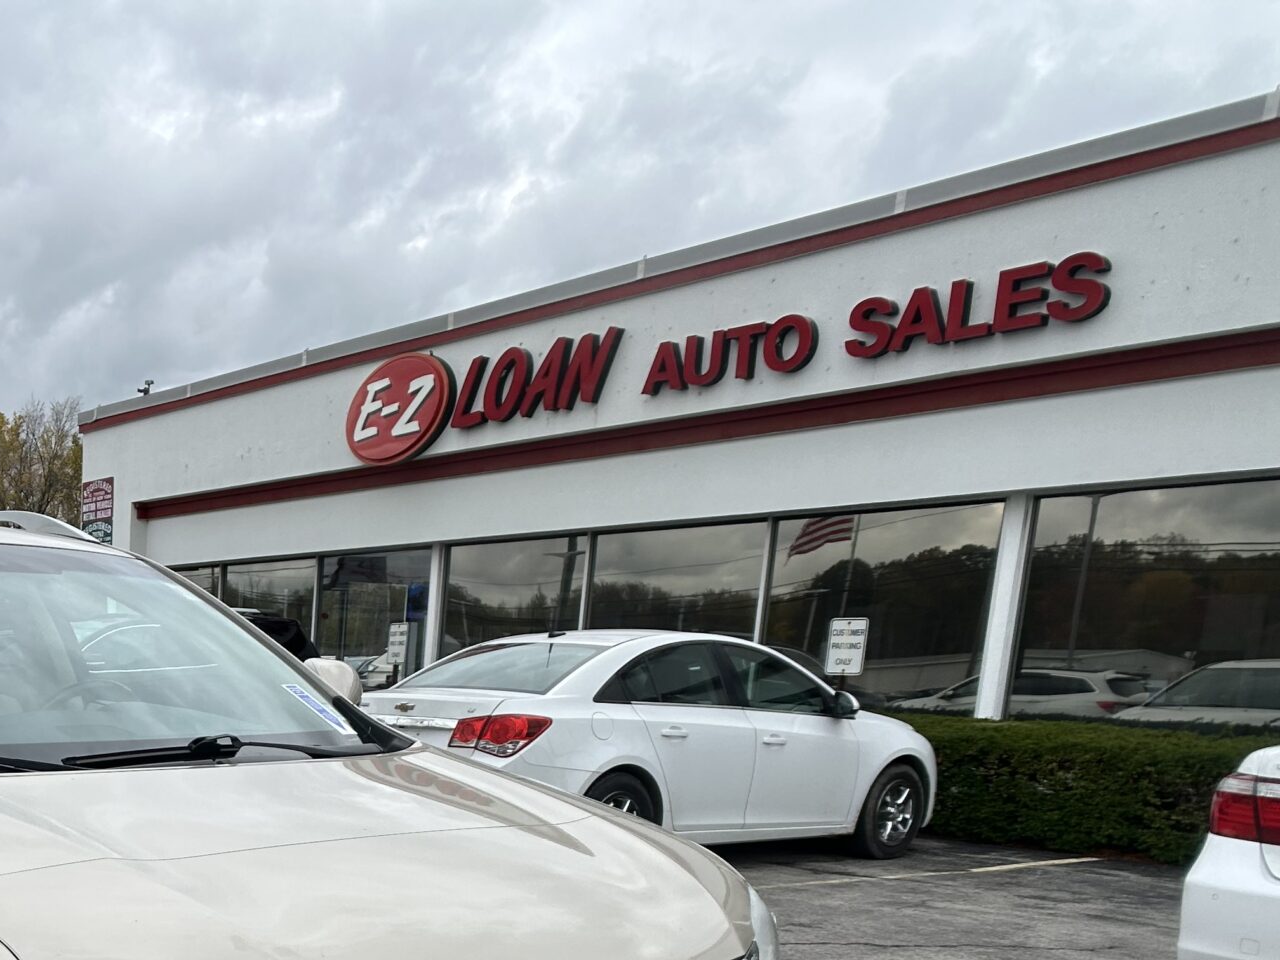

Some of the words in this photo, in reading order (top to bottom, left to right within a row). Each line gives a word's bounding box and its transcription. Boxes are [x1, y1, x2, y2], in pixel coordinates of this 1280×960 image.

[353, 373, 436, 442] E-Z
[450, 326, 625, 429] LOAN
[641, 313, 820, 396] AUTO
[844, 251, 1113, 360] SALES
[835, 657, 853, 665] ONLY
